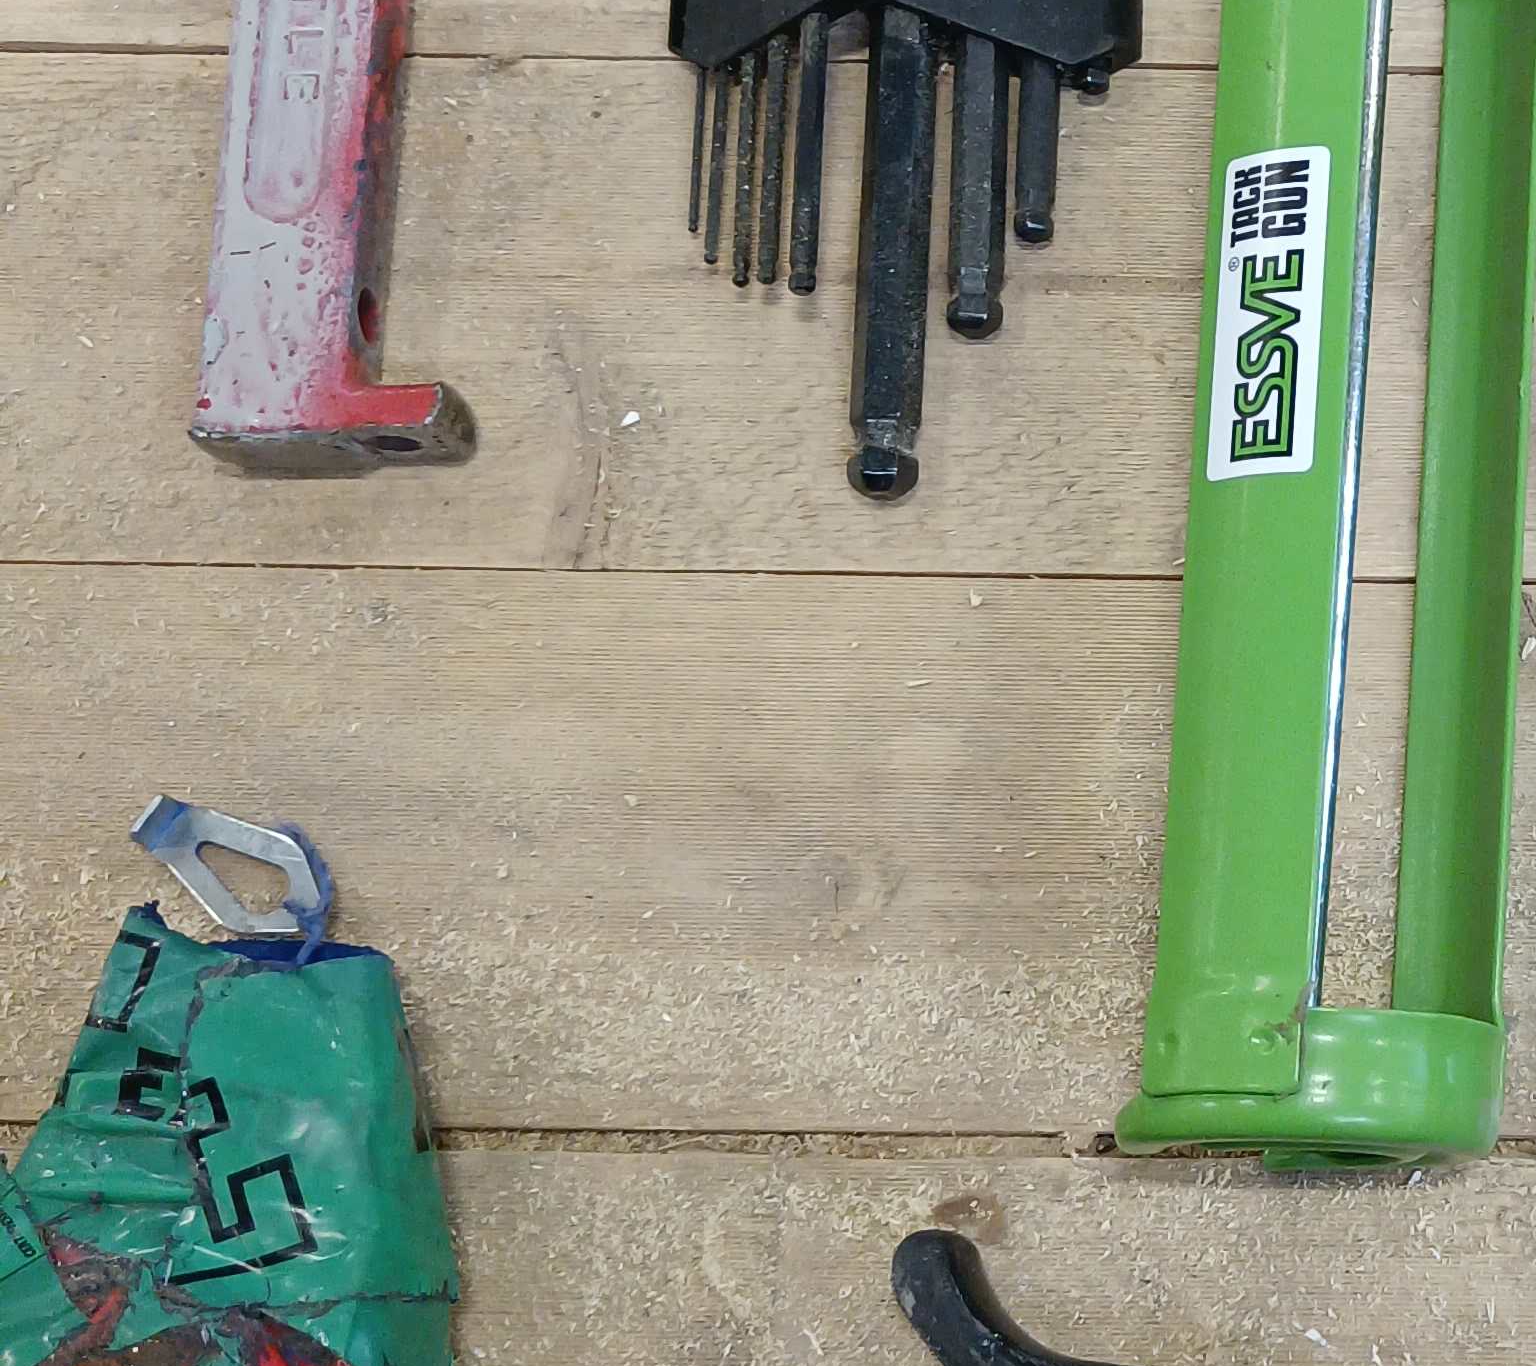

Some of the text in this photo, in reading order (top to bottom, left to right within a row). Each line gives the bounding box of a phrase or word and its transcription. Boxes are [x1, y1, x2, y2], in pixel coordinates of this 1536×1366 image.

[1230, 164, 1263, 249] TACK
[1261, 158, 1311, 238] GUN
[1230, 248, 1305, 464] ESSVE
